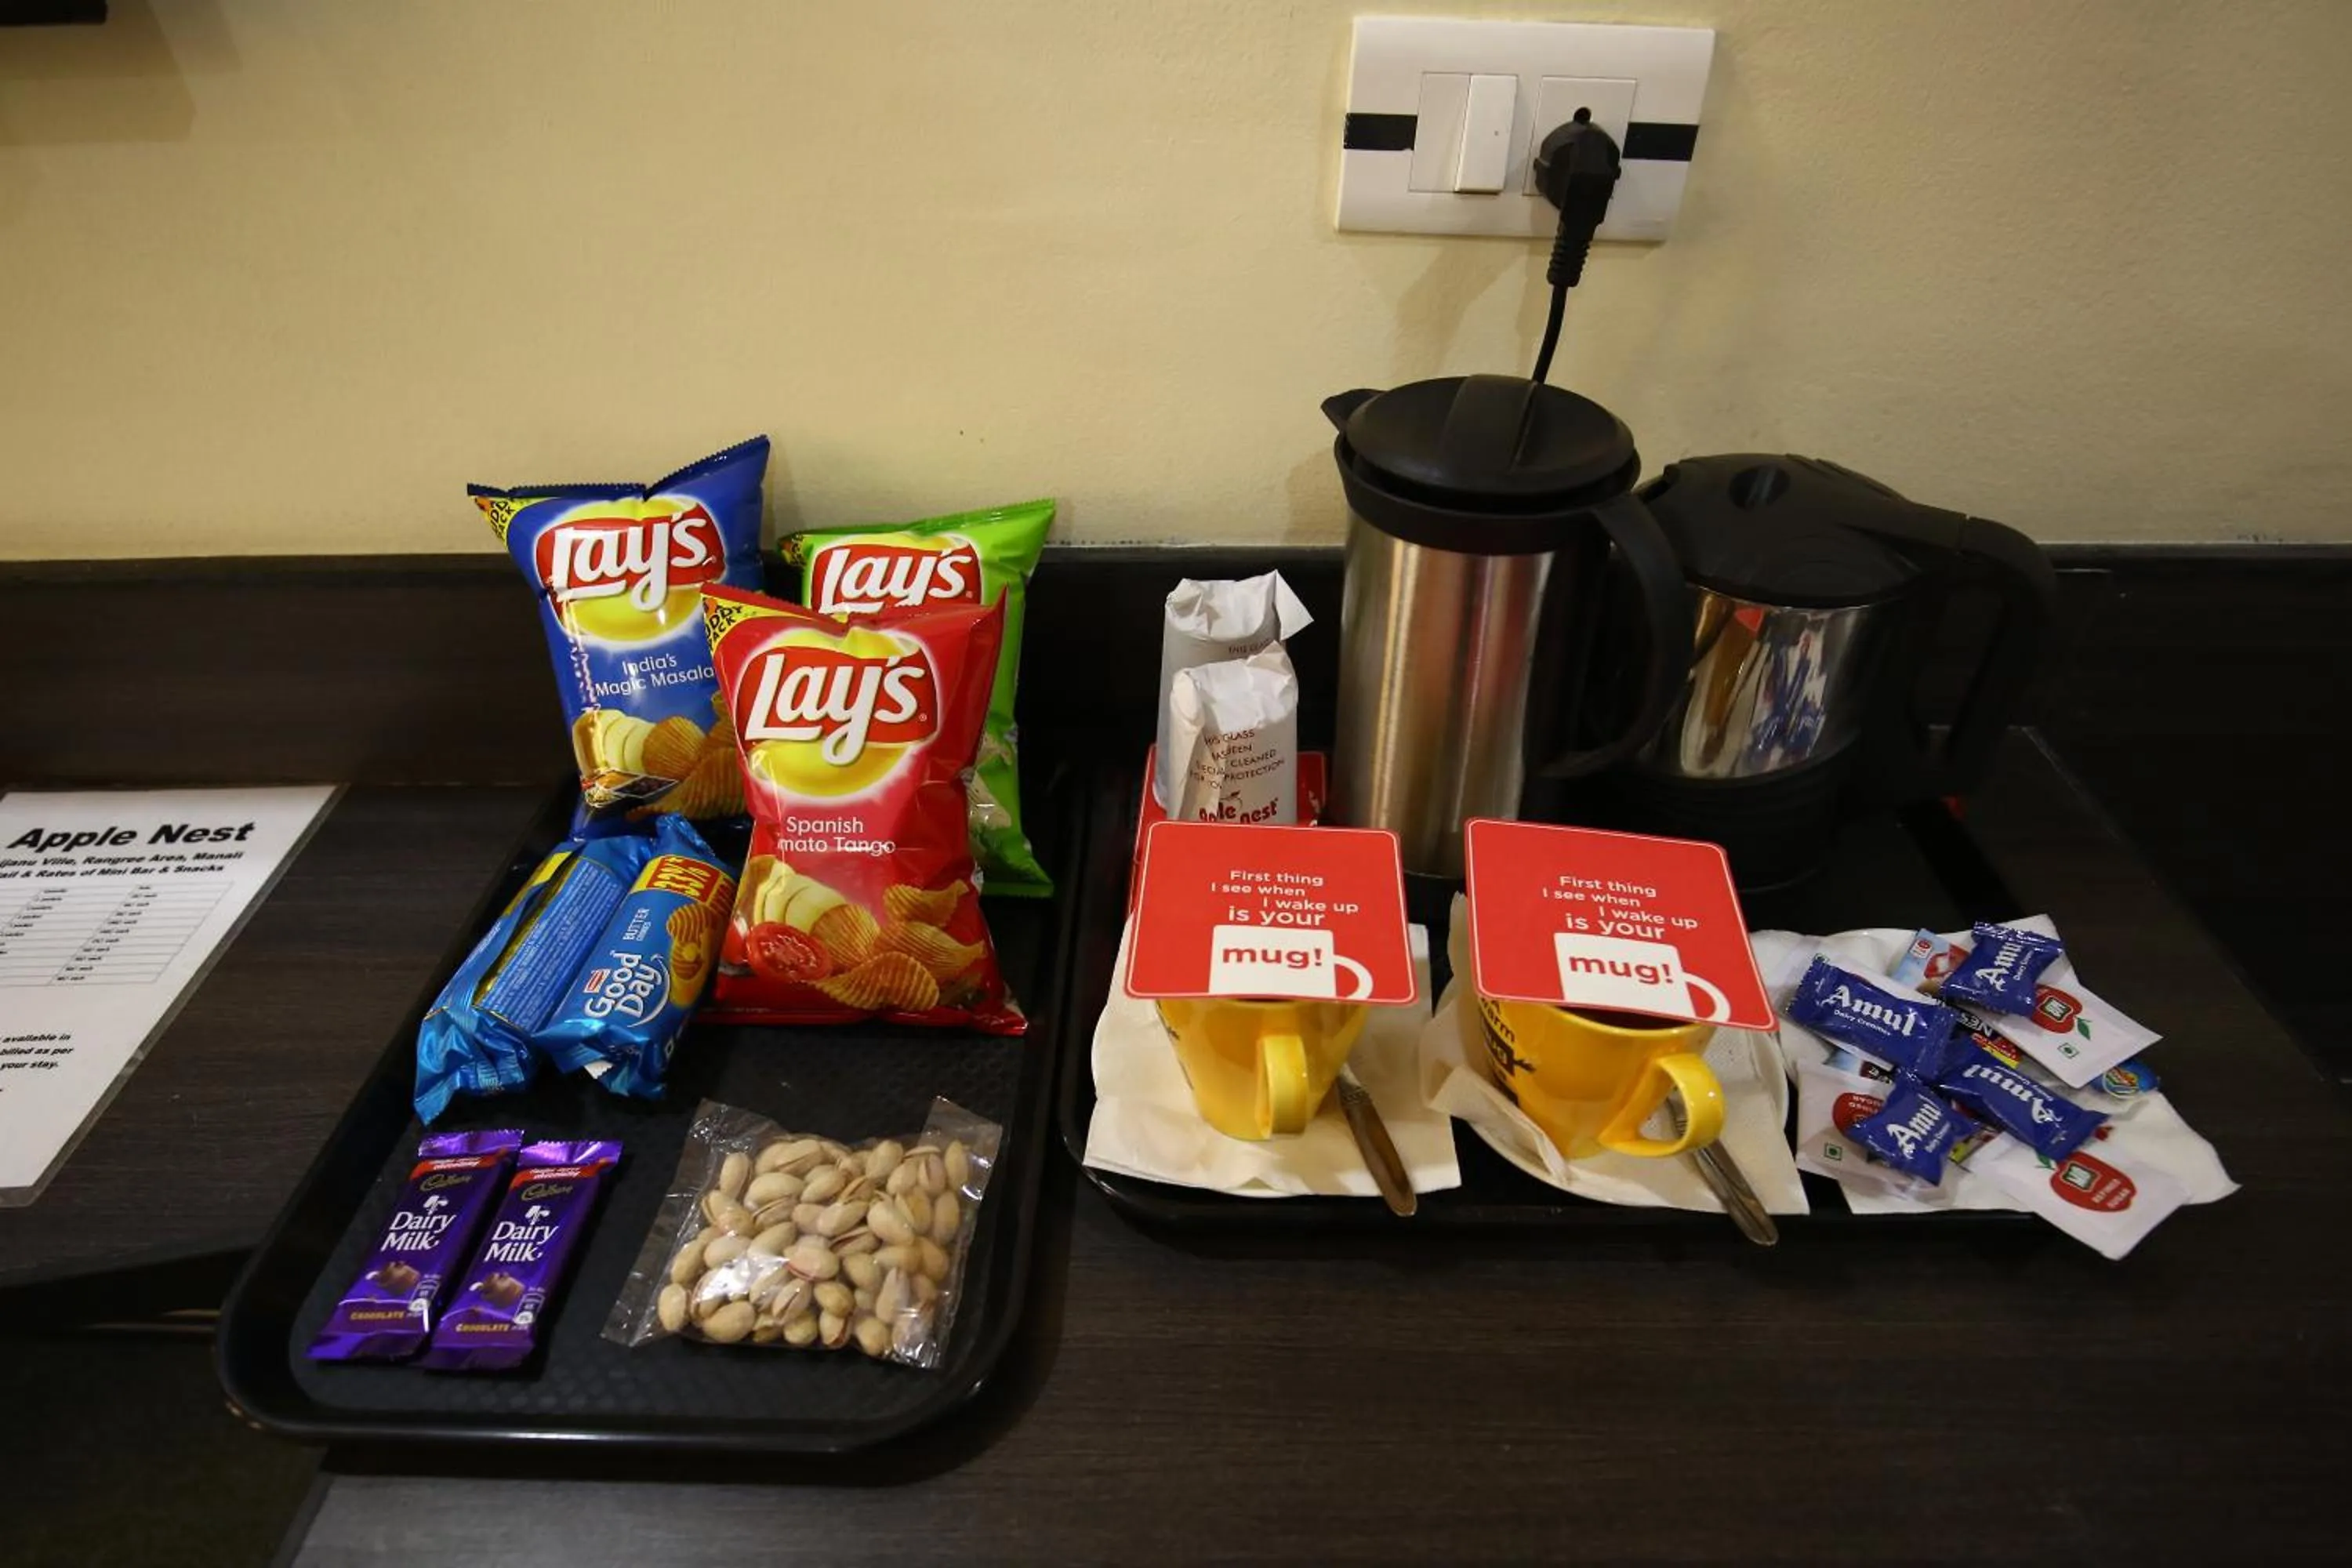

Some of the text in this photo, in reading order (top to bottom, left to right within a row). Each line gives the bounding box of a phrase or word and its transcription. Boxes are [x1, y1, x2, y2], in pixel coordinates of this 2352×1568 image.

[551, 511, 707, 612] Lay's
[818, 548, 972, 614] Lay's
[622, 653, 677, 677] India's
[595, 664, 715, 696] Magic Masala
[744, 654, 926, 767] Lay's
[1231, 749, 1276, 768] CLEANED
[1224, 759, 1285, 782] PROTECTION
[6, 821, 256, 853] Apple Nest
[786, 816, 864, 836] Spanish
[82, 855, 146, 864] Rangree
[193, 851, 245, 860] Manali
[833, 837, 895, 857] Tango
[97, 867, 129, 876] Mini
[129, 866, 156, 875] Bar
[173, 865, 224, 873] Snacks
[1229, 869, 1323, 887] First thing
[1211, 882, 1306, 897] I see when
[1542, 887, 1641, 908] I see when
[1559, 875, 1657, 898] First thing
[1228, 905, 1327, 927] is your
[1263, 897, 1359, 915] I wake up
[1565, 913, 1665, 940] is your
[1599, 906, 1699, 930] I wake up
[1221, 946, 1323, 969] mug!
[1569, 956, 1674, 985] mug!
[583, 950, 642, 1018] Good
[615, 964, 662, 1018] Day
[1820, 985, 1918, 1036] Amul
[2, 1033, 57, 1044] available
[50, 1047, 74, 1056] per
[0, 1062, 28, 1071] your
[1962, 1064, 2063, 1126] Amul
[389, 1211, 457, 1234] Dairy
[491, 1221, 559, 1245] Dairy
[380, 1230, 440, 1252] Milk
[483, 1242, 543, 1263] Milk
